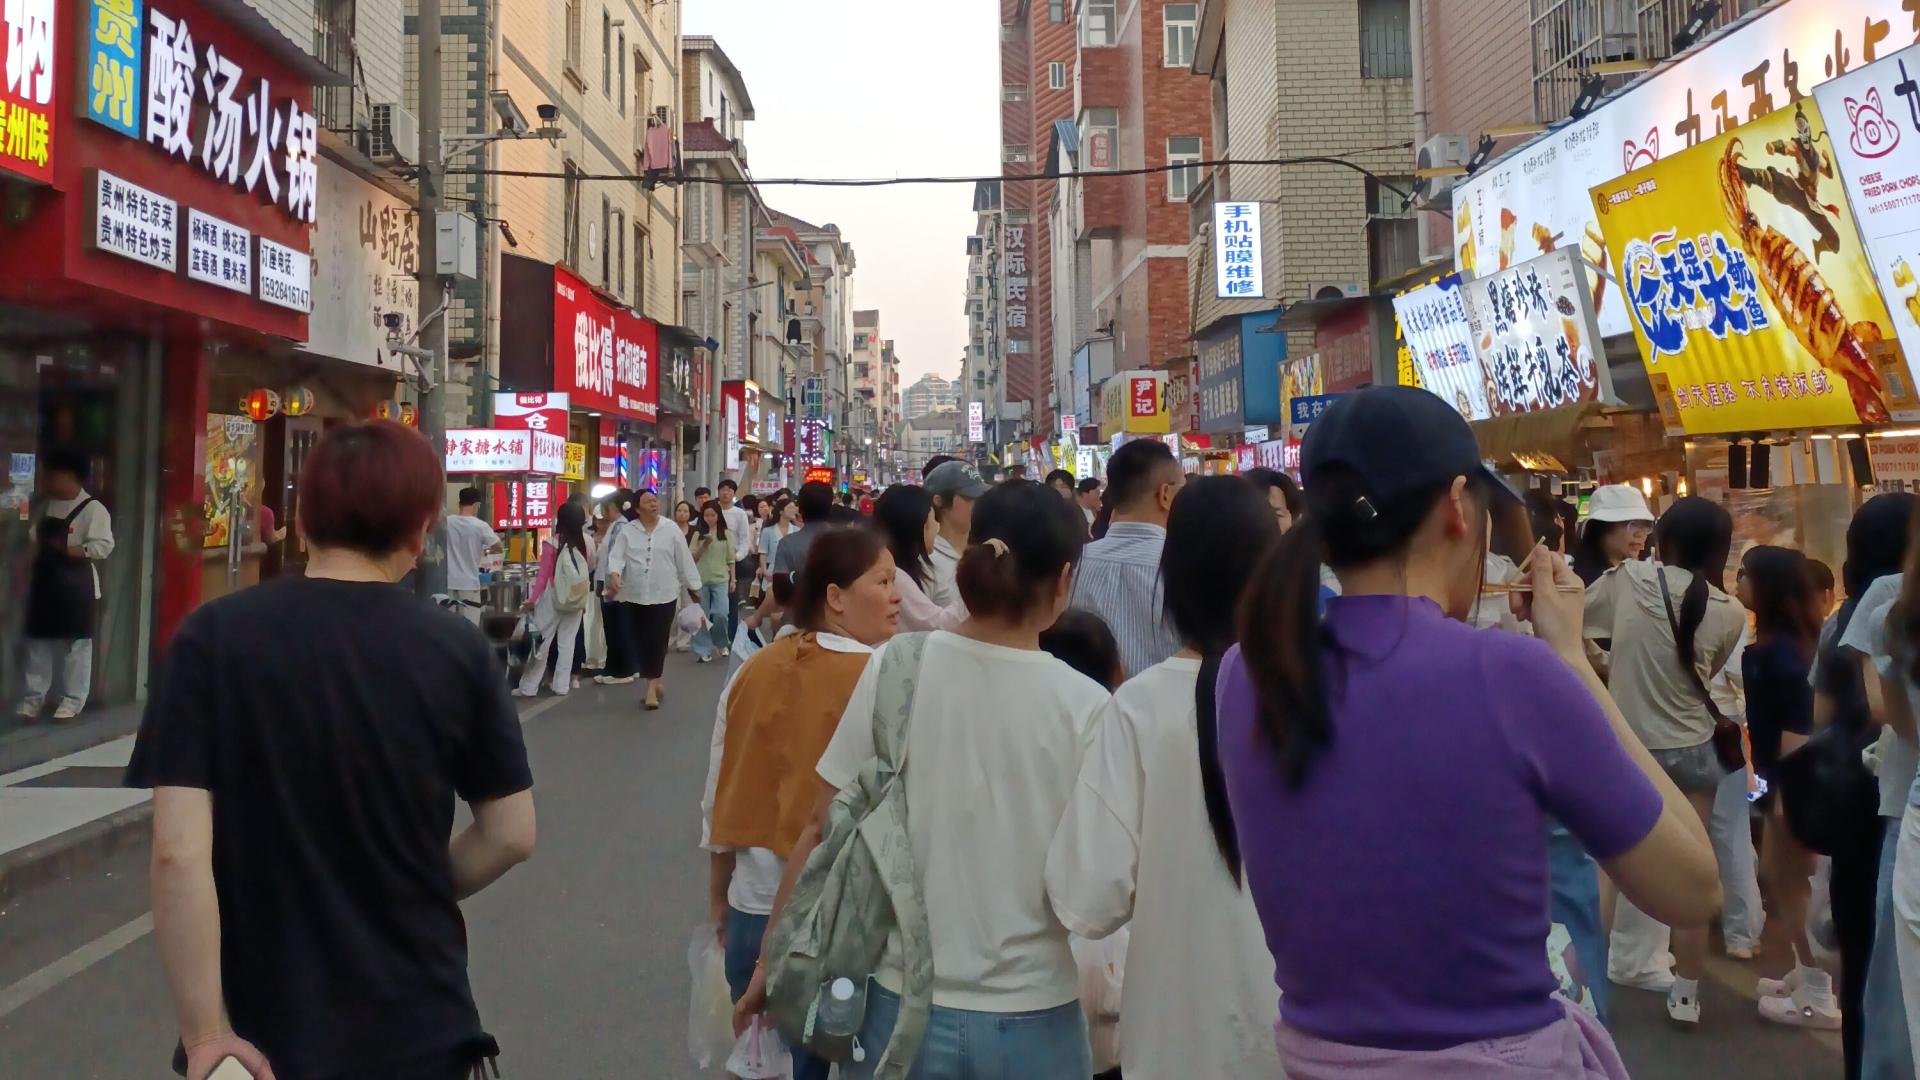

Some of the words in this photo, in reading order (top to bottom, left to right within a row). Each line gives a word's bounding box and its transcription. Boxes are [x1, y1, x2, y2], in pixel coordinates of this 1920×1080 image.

[146, 7, 318, 224] 酸汤火锅
[1859, 172, 1883, 186] CHEESE
[100, 178, 173, 232] 贵州特色凉菜
[100, 215, 172, 265] 贵州特色炒菜
[192, 216, 218, 249] 杨梅酒
[1224, 204, 1255, 295] 手机贴膜维修
[191, 247, 218, 278] 蓝莓酒
[1006, 226, 1027, 328] 汉际民宿
[1135, 379, 1155, 414] 尹记
[1297, 400, 1332, 419] 我在
